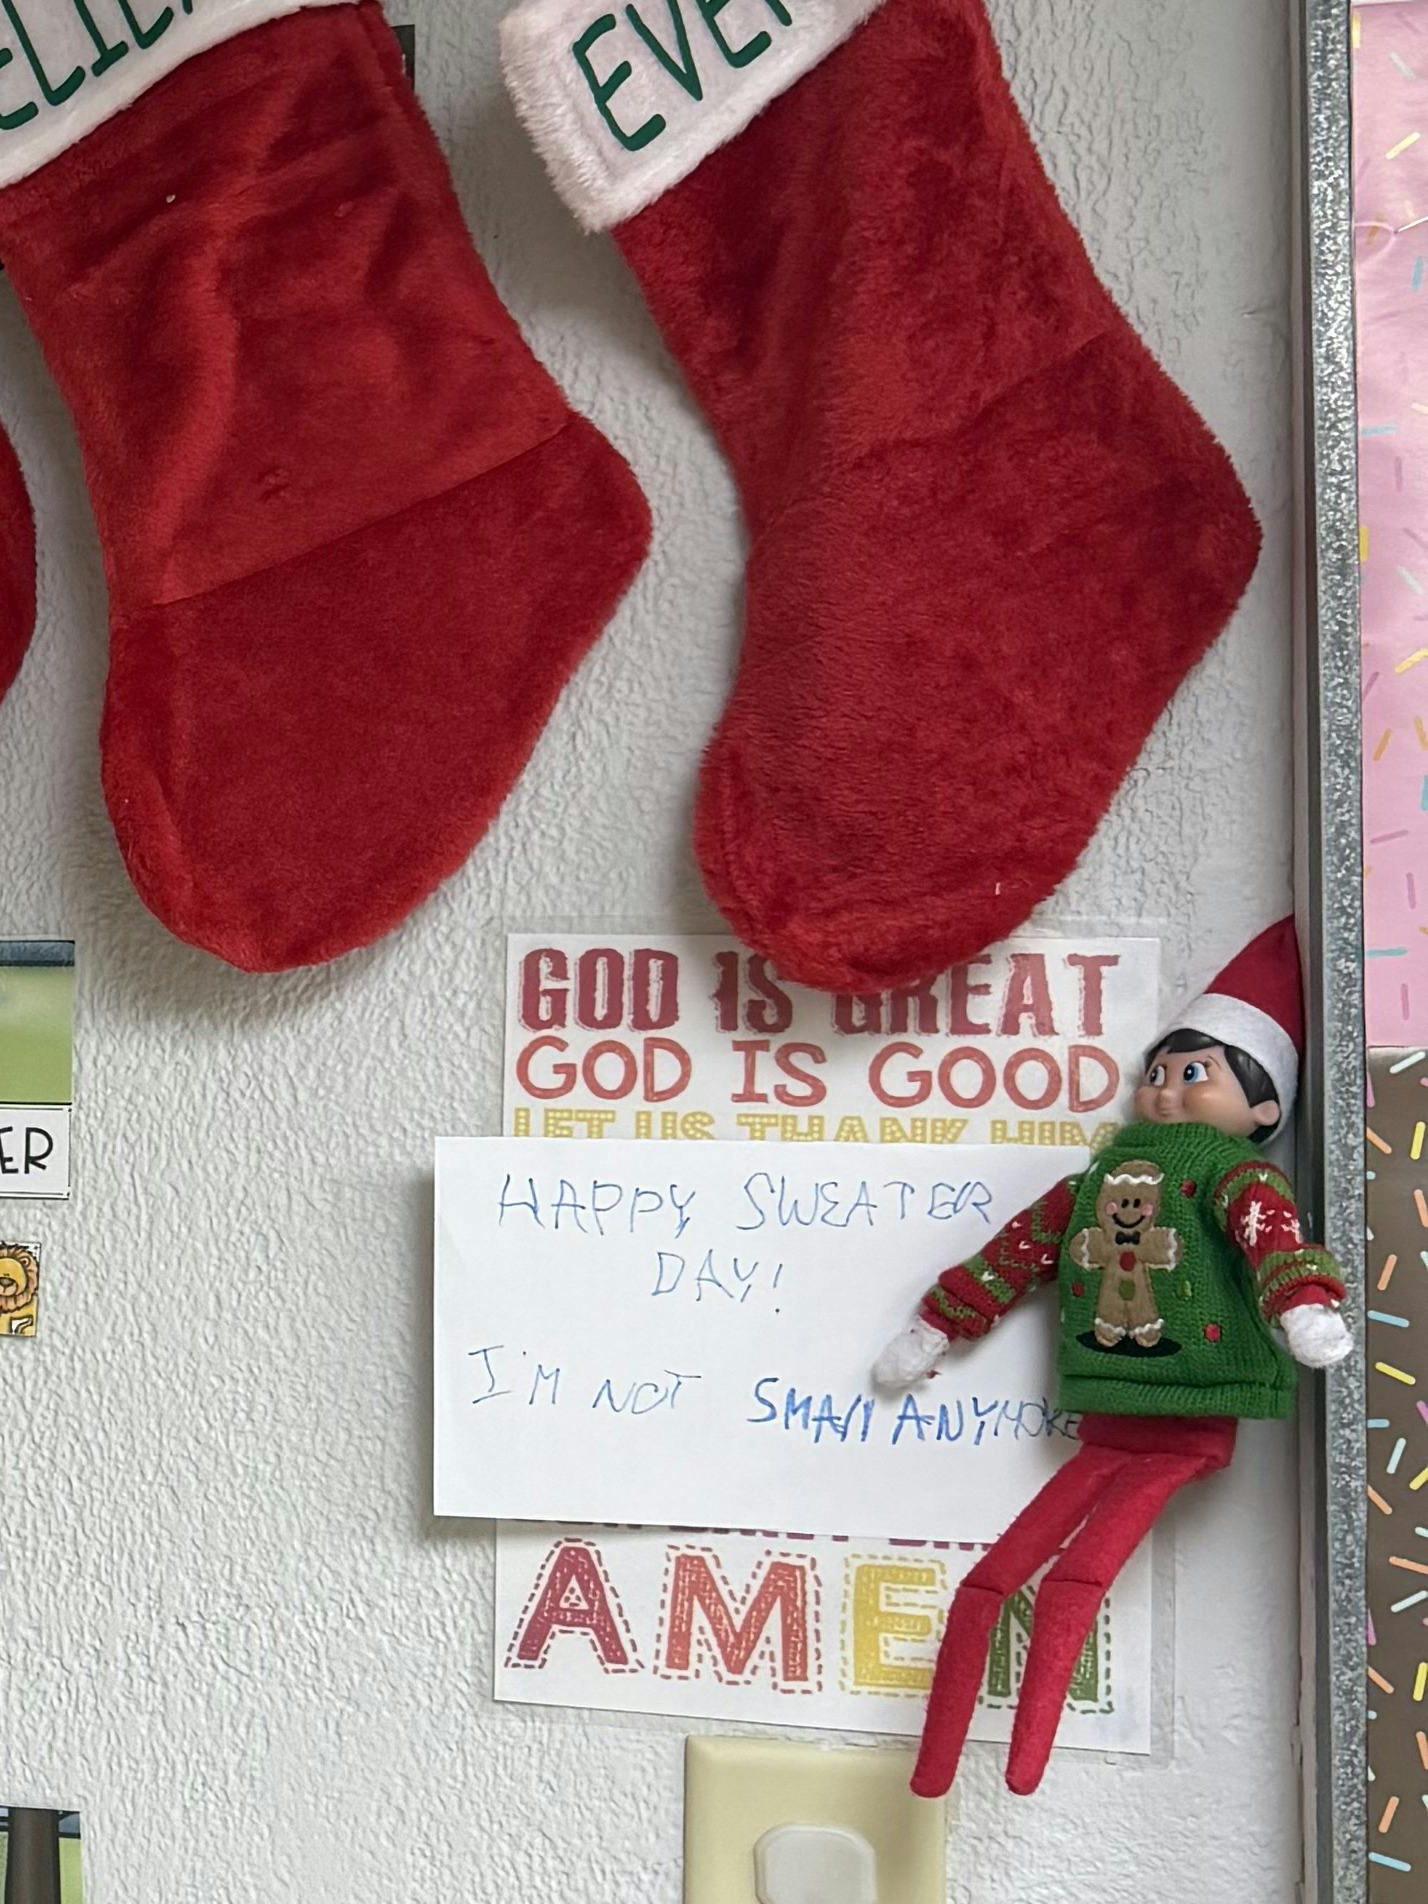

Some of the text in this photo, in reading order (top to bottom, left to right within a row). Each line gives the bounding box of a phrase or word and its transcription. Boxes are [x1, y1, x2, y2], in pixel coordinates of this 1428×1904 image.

[518, 947, 680, 1033] GOD
[712, 950, 794, 1034] IS
[515, 1035, 1122, 1114] GOD IS GOOD
[499, 1172, 993, 1238] HAPPY SWEATER
[651, 1249, 785, 1313] DAY!
[591, 1369, 702, 1415] NOT
